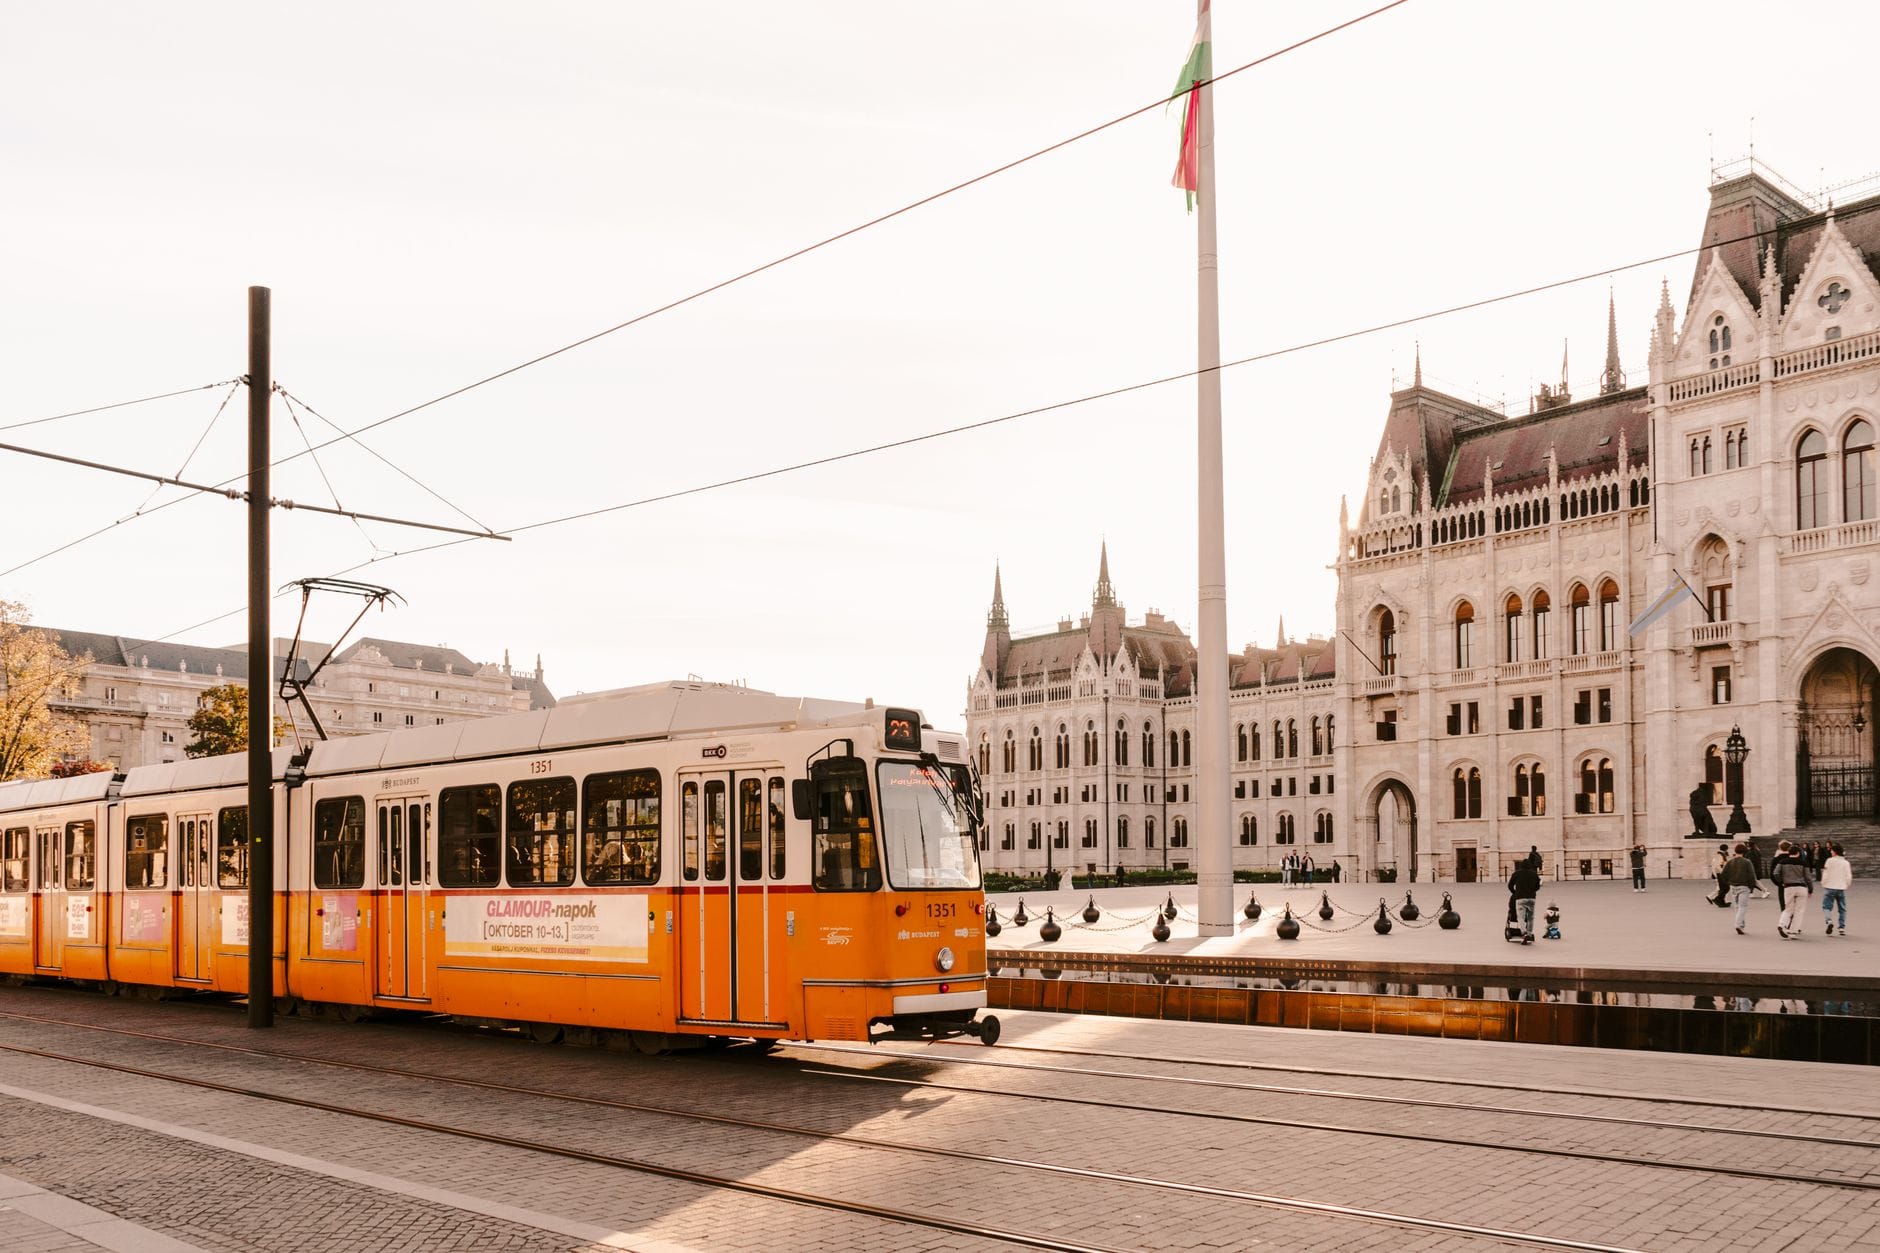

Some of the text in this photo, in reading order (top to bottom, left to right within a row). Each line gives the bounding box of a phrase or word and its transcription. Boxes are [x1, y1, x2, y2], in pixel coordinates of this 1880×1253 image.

[530, 759, 552, 774] 1351
[392, 777, 420, 786] BUDAPEST
[926, 903, 956, 918] 1351
